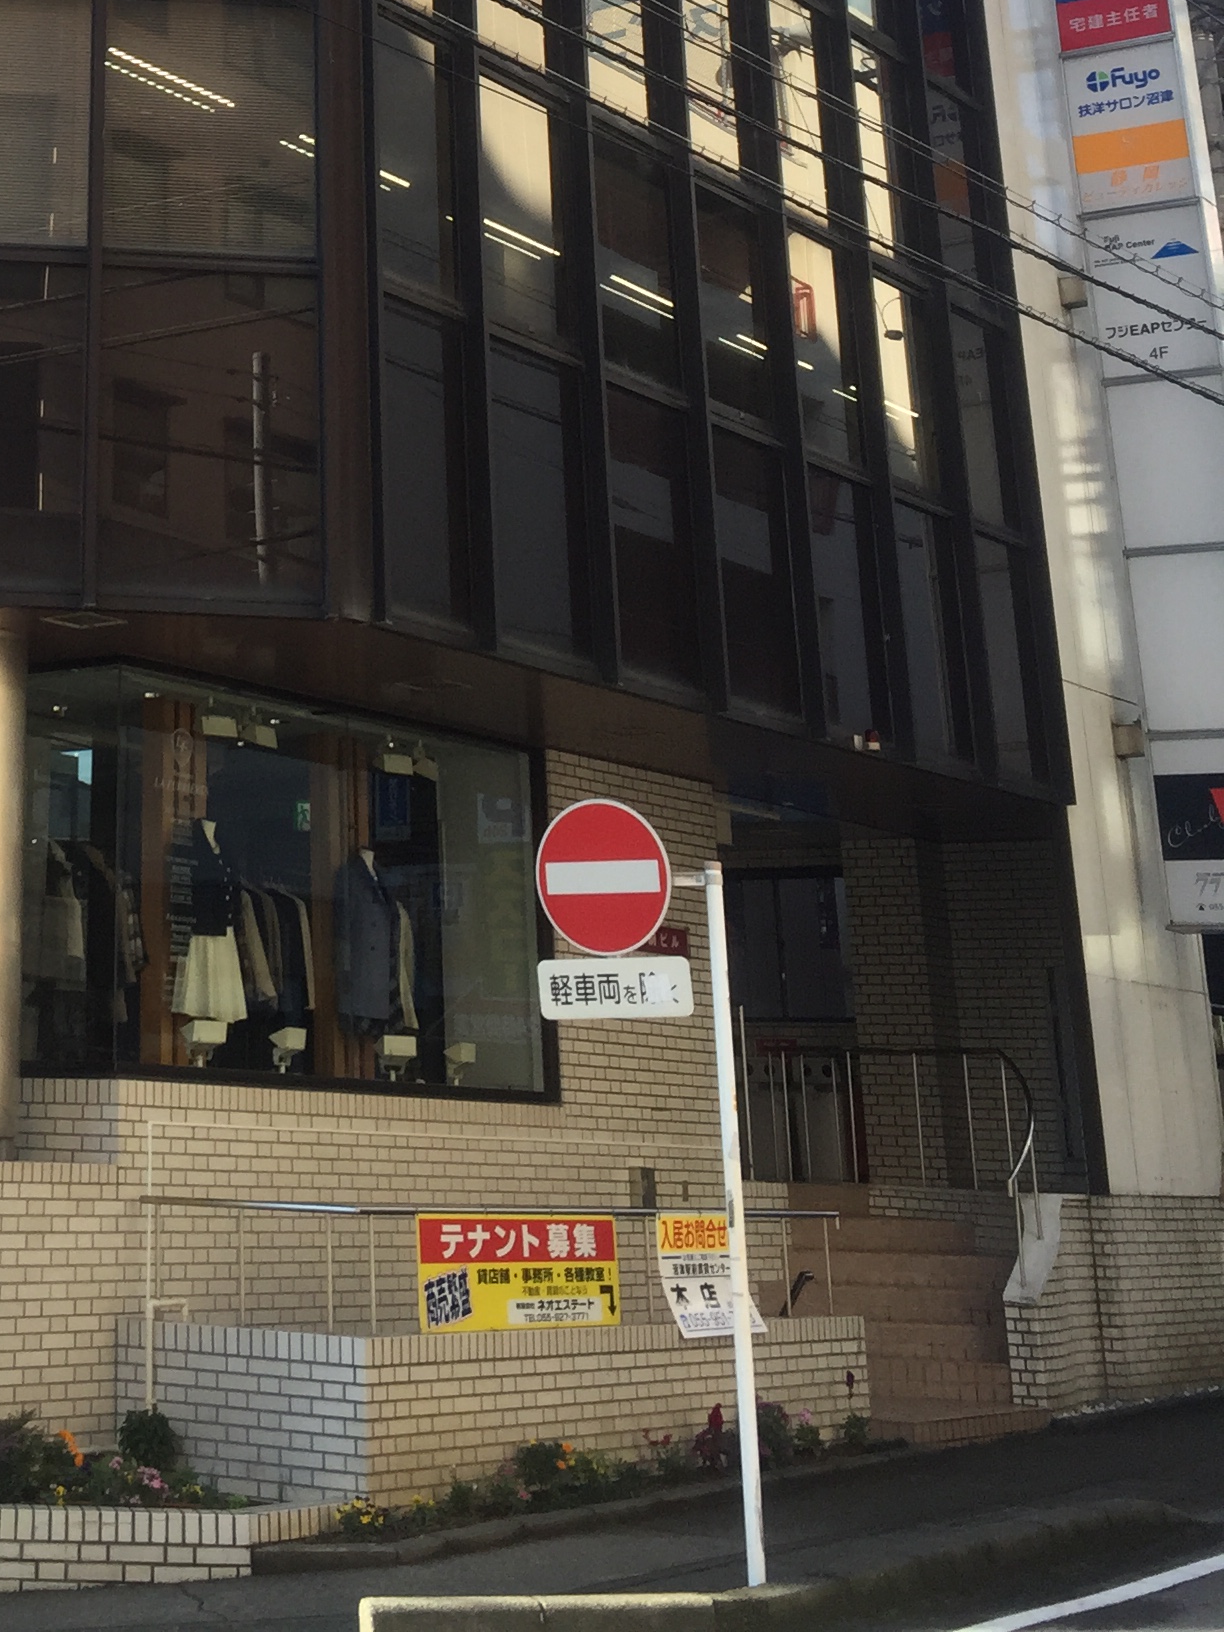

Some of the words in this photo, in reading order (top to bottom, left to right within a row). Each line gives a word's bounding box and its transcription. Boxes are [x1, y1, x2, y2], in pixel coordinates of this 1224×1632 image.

[1069, 3, 1158, 32] 宅建主任者
[1110, 67, 1161, 89] Fuyo
[1078, 89, 1174, 118] 扶洋サロン沼津
[1126, 239, 1155, 249] Center
[1149, 346, 1169, 359] 4F
[440, 1223, 598, 1259] テナント募集
[660, 1219, 728, 1249] 入居お問合せ
